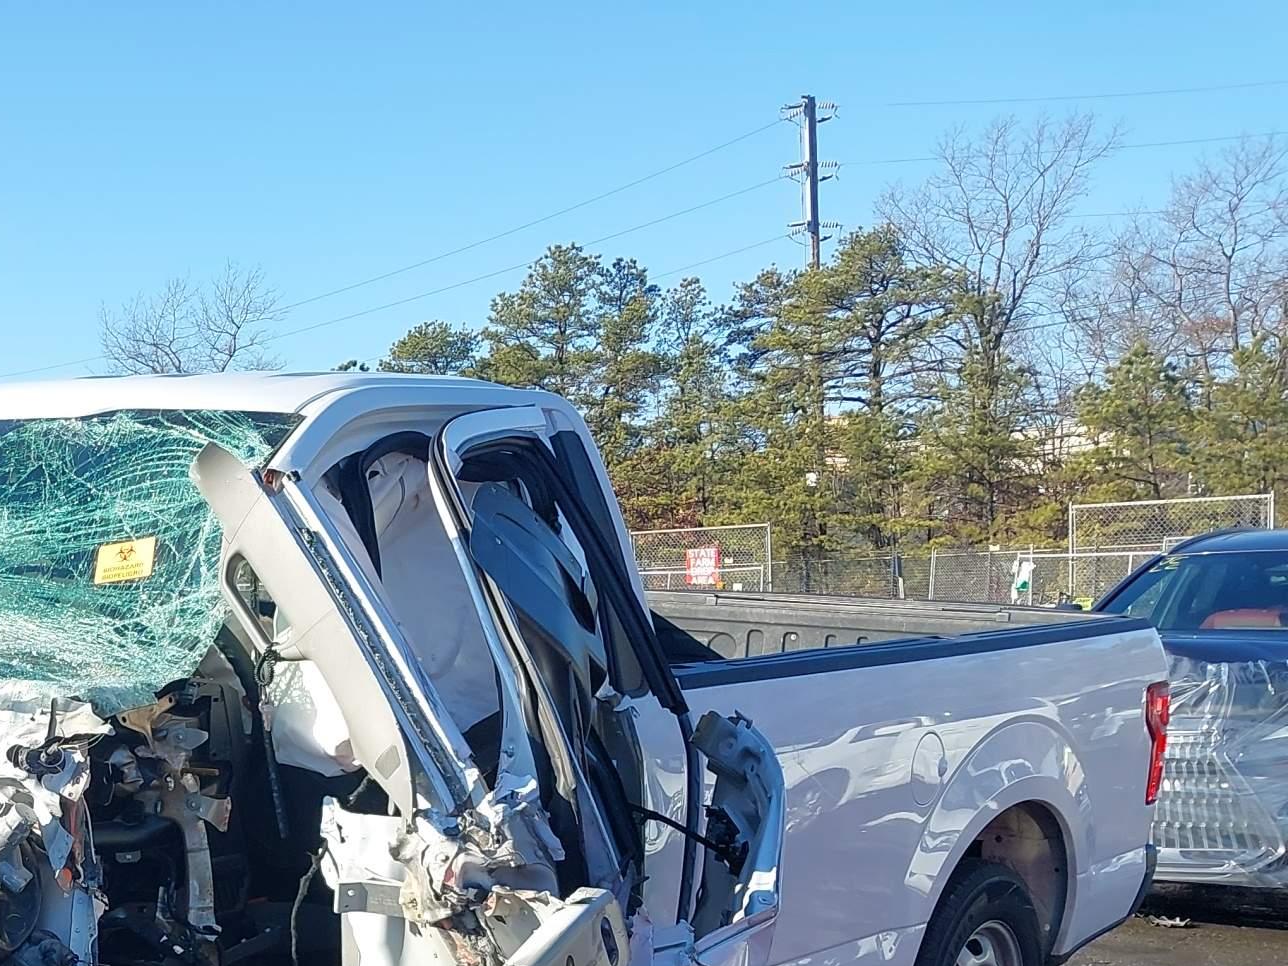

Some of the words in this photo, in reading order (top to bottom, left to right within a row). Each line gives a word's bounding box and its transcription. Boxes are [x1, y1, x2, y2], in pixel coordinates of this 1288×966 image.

[688, 548, 717, 558] STATE
[690, 557, 716, 567] FARM
[103, 563, 144, 573] BIOHAZARD
[691, 576, 716, 585] AREA
